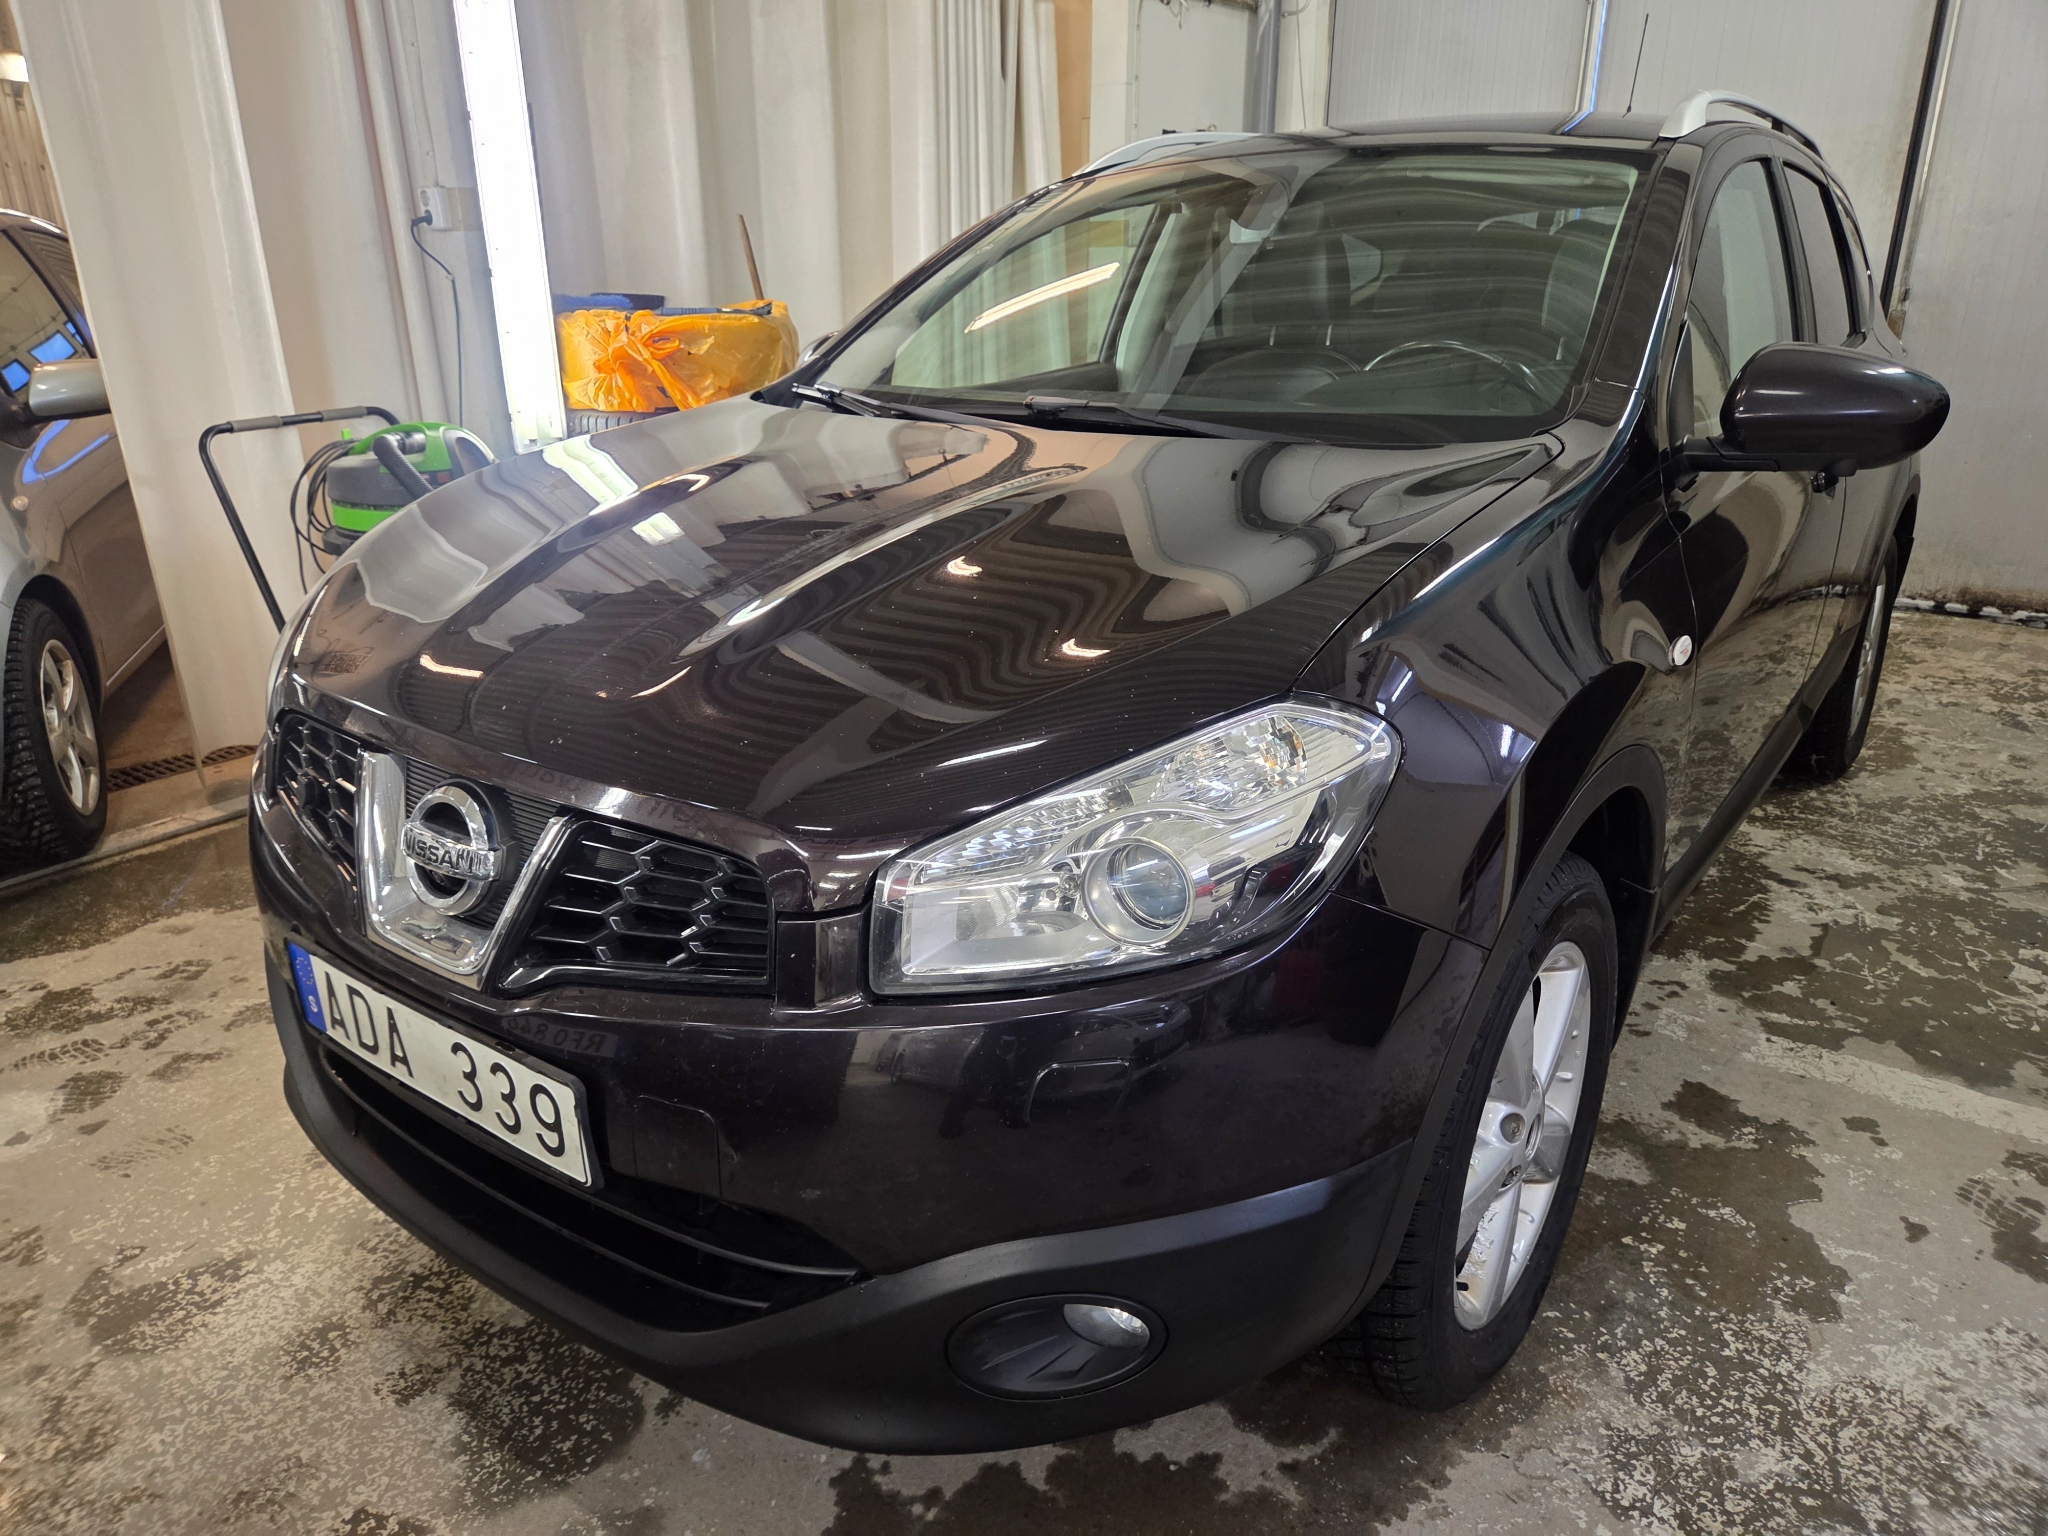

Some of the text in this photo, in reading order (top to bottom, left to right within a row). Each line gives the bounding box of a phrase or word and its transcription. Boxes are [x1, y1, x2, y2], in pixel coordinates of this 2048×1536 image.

[403, 831, 473, 874] NISSAN
[325, 970, 566, 1158] ADA 339
